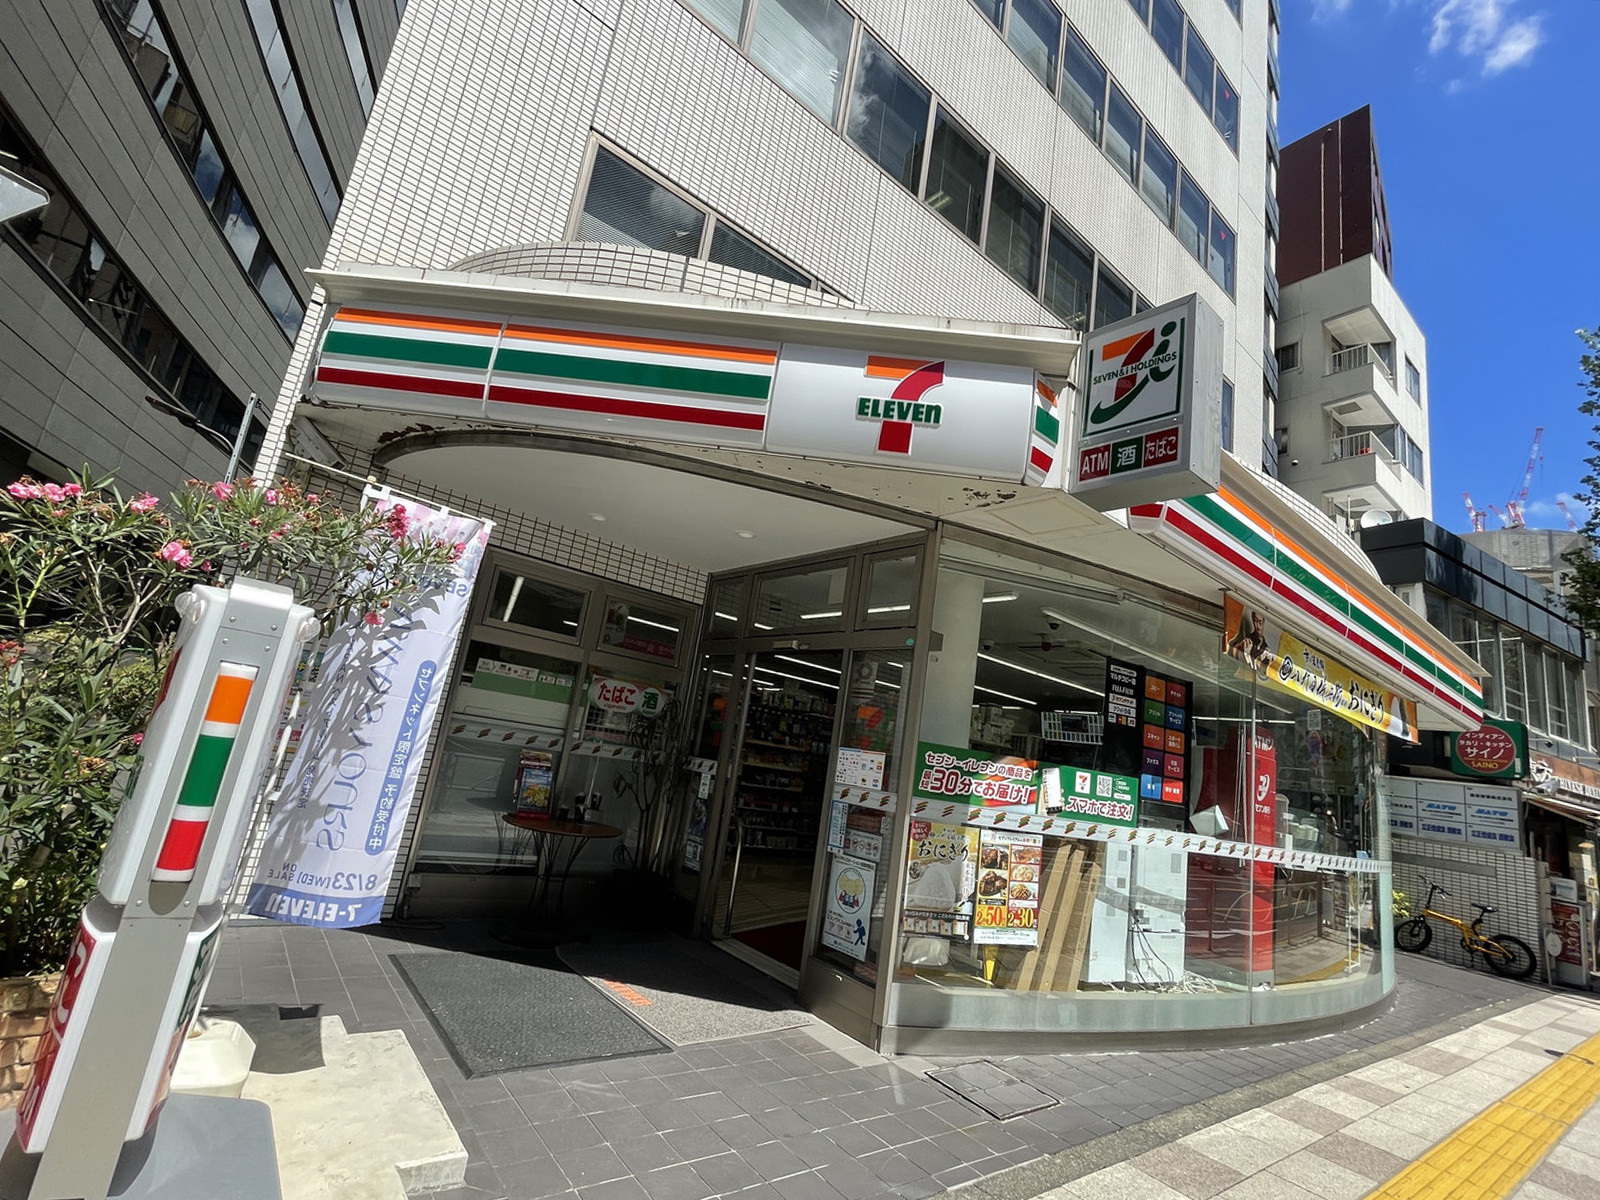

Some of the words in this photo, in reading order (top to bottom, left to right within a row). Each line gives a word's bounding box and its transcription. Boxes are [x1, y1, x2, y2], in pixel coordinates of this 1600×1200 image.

[1131, 351, 1178, 372] HOLDINGS
[1117, 445, 1137, 467] 酒
[1145, 435, 1176, 460] たばこ
[1082, 452, 1108, 474] ATM
[598, 683, 636, 705] たばこ
[642, 691, 659, 709] 酒
[1348, 680, 1385, 724] おにぎり
[1465, 732, 1505, 740] インディアン
[1465, 747, 1504, 759] サイノ
[1471, 761, 1499, 769] SAINO
[1067, 797, 1134, 819] スマホで注文!
[919, 840, 969, 861] おにぎり
